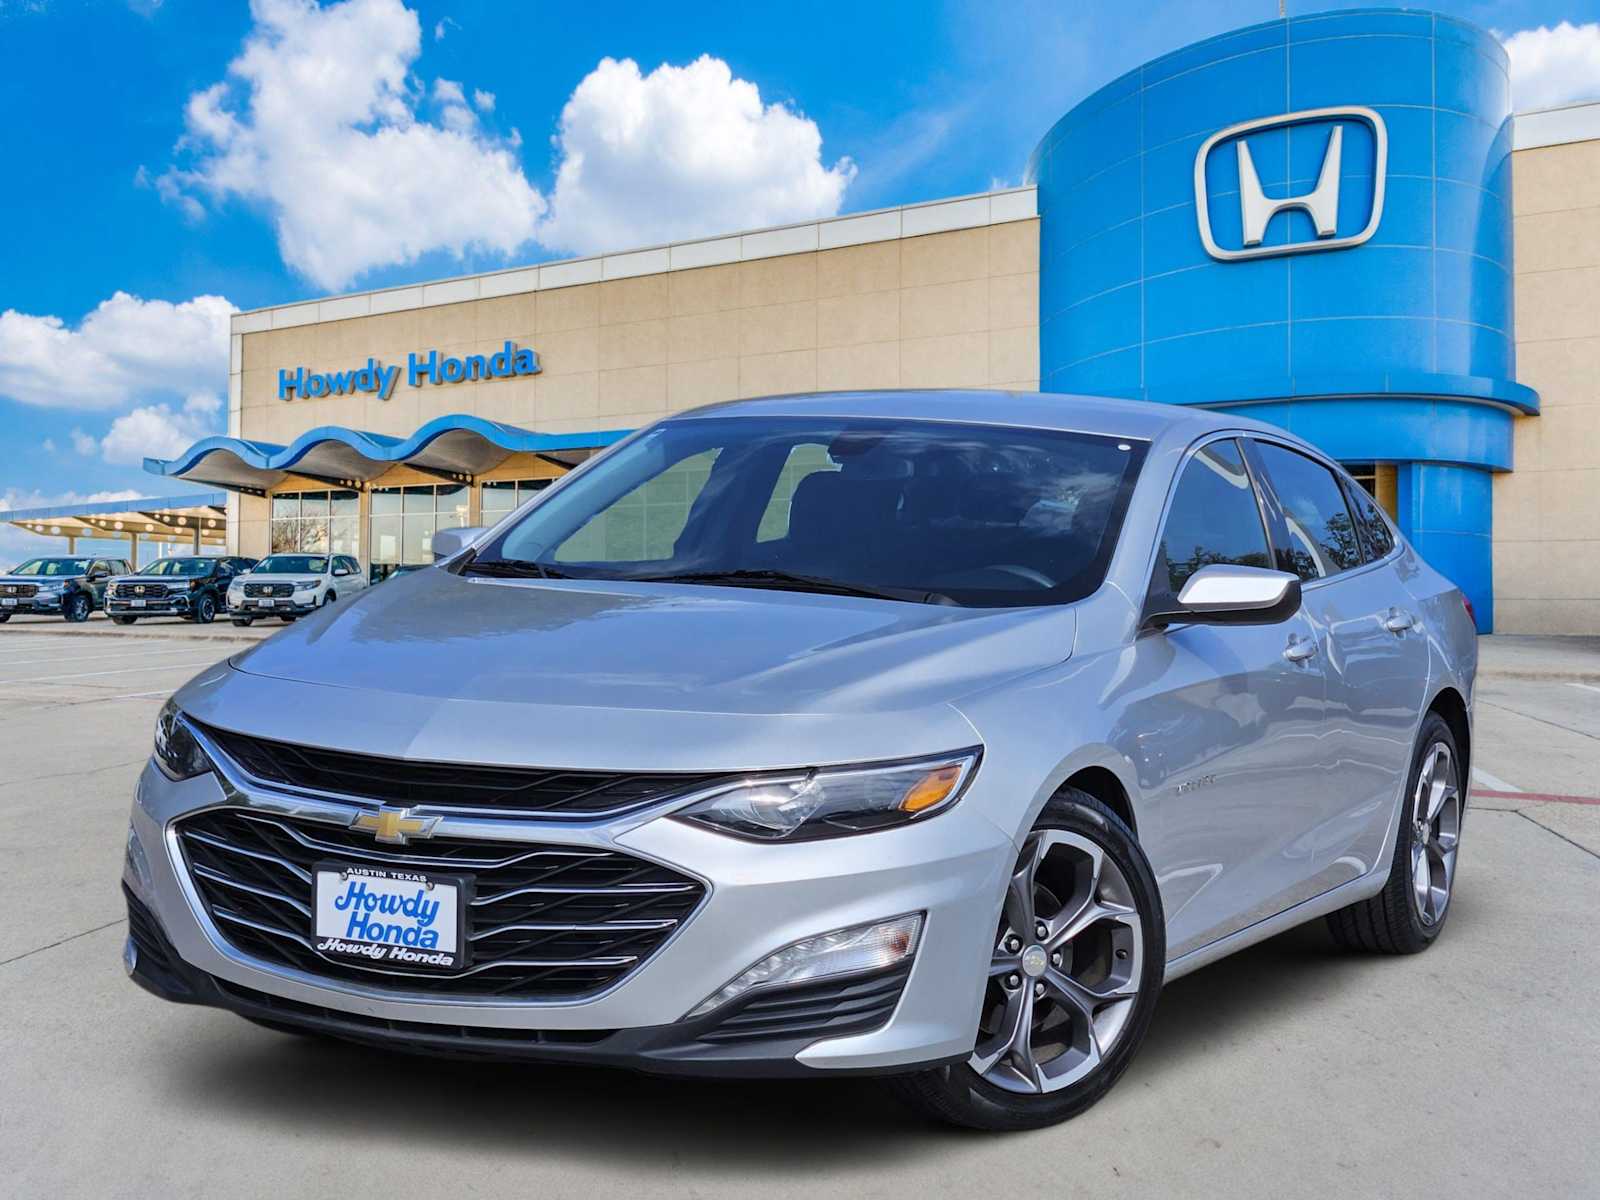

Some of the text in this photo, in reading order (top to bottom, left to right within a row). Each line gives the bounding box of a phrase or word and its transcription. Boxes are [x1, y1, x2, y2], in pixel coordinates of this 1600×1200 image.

[278, 340, 541, 400] Howdy Honda
[346, 867, 428, 882] AUSTIN TEXAS
[335, 881, 440, 927] Howdy
[346, 911, 440, 949] Honda
[317, 938, 454, 966] Howdy Honda
